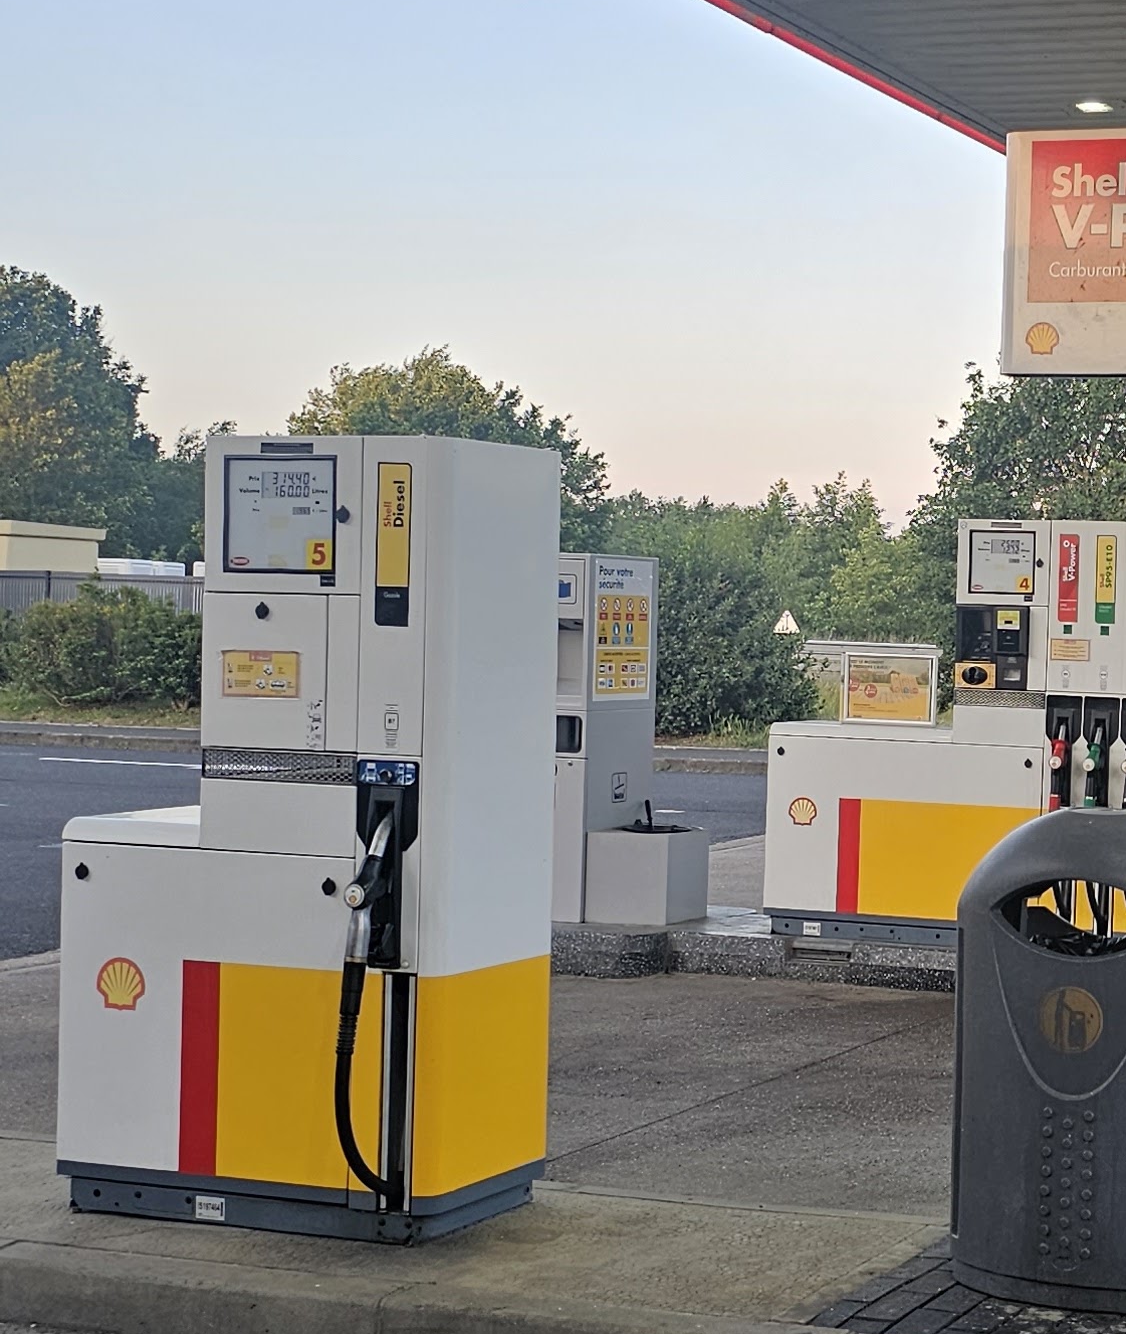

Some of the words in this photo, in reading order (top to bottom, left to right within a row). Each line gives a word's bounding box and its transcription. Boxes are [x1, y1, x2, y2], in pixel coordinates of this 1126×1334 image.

[383, 501, 392, 528] Shell
[393, 480, 406, 528] Diesel
[312, 542, 326, 566] 5
[1068, 543, 1077, 582] V-Power
[1105, 544, 1113, 588] SP95-E10
[599, 565, 615, 576] Pour
[617, 568, 633, 577] votre
[599, 578, 624, 589] sécurité
[1019, 578, 1030, 590] 4
